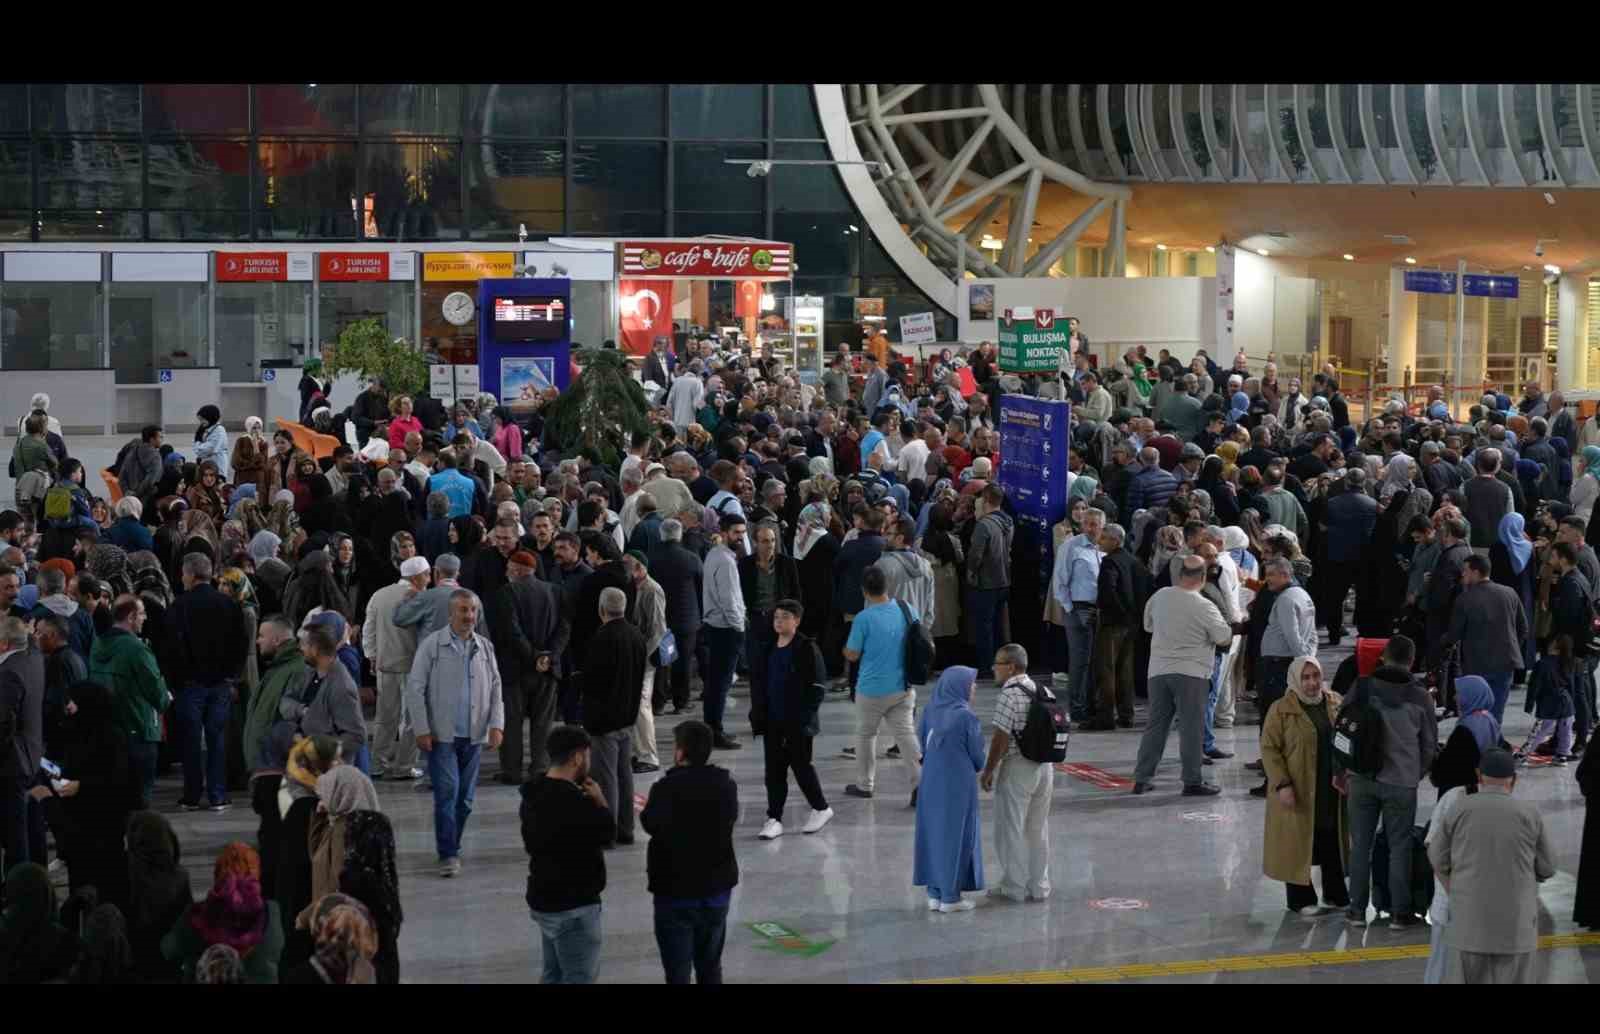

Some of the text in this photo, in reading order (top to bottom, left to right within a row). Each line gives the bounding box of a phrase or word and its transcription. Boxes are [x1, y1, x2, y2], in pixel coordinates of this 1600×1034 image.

[703, 248, 712, 260] &
[243, 258, 280, 266] TURKISH
[346, 258, 381, 266] TURKISH
[243, 266, 280, 274] AIRLINES
[345, 266, 381, 274] AIRLINES
[1023, 332, 1066, 345] BULUŞMA
